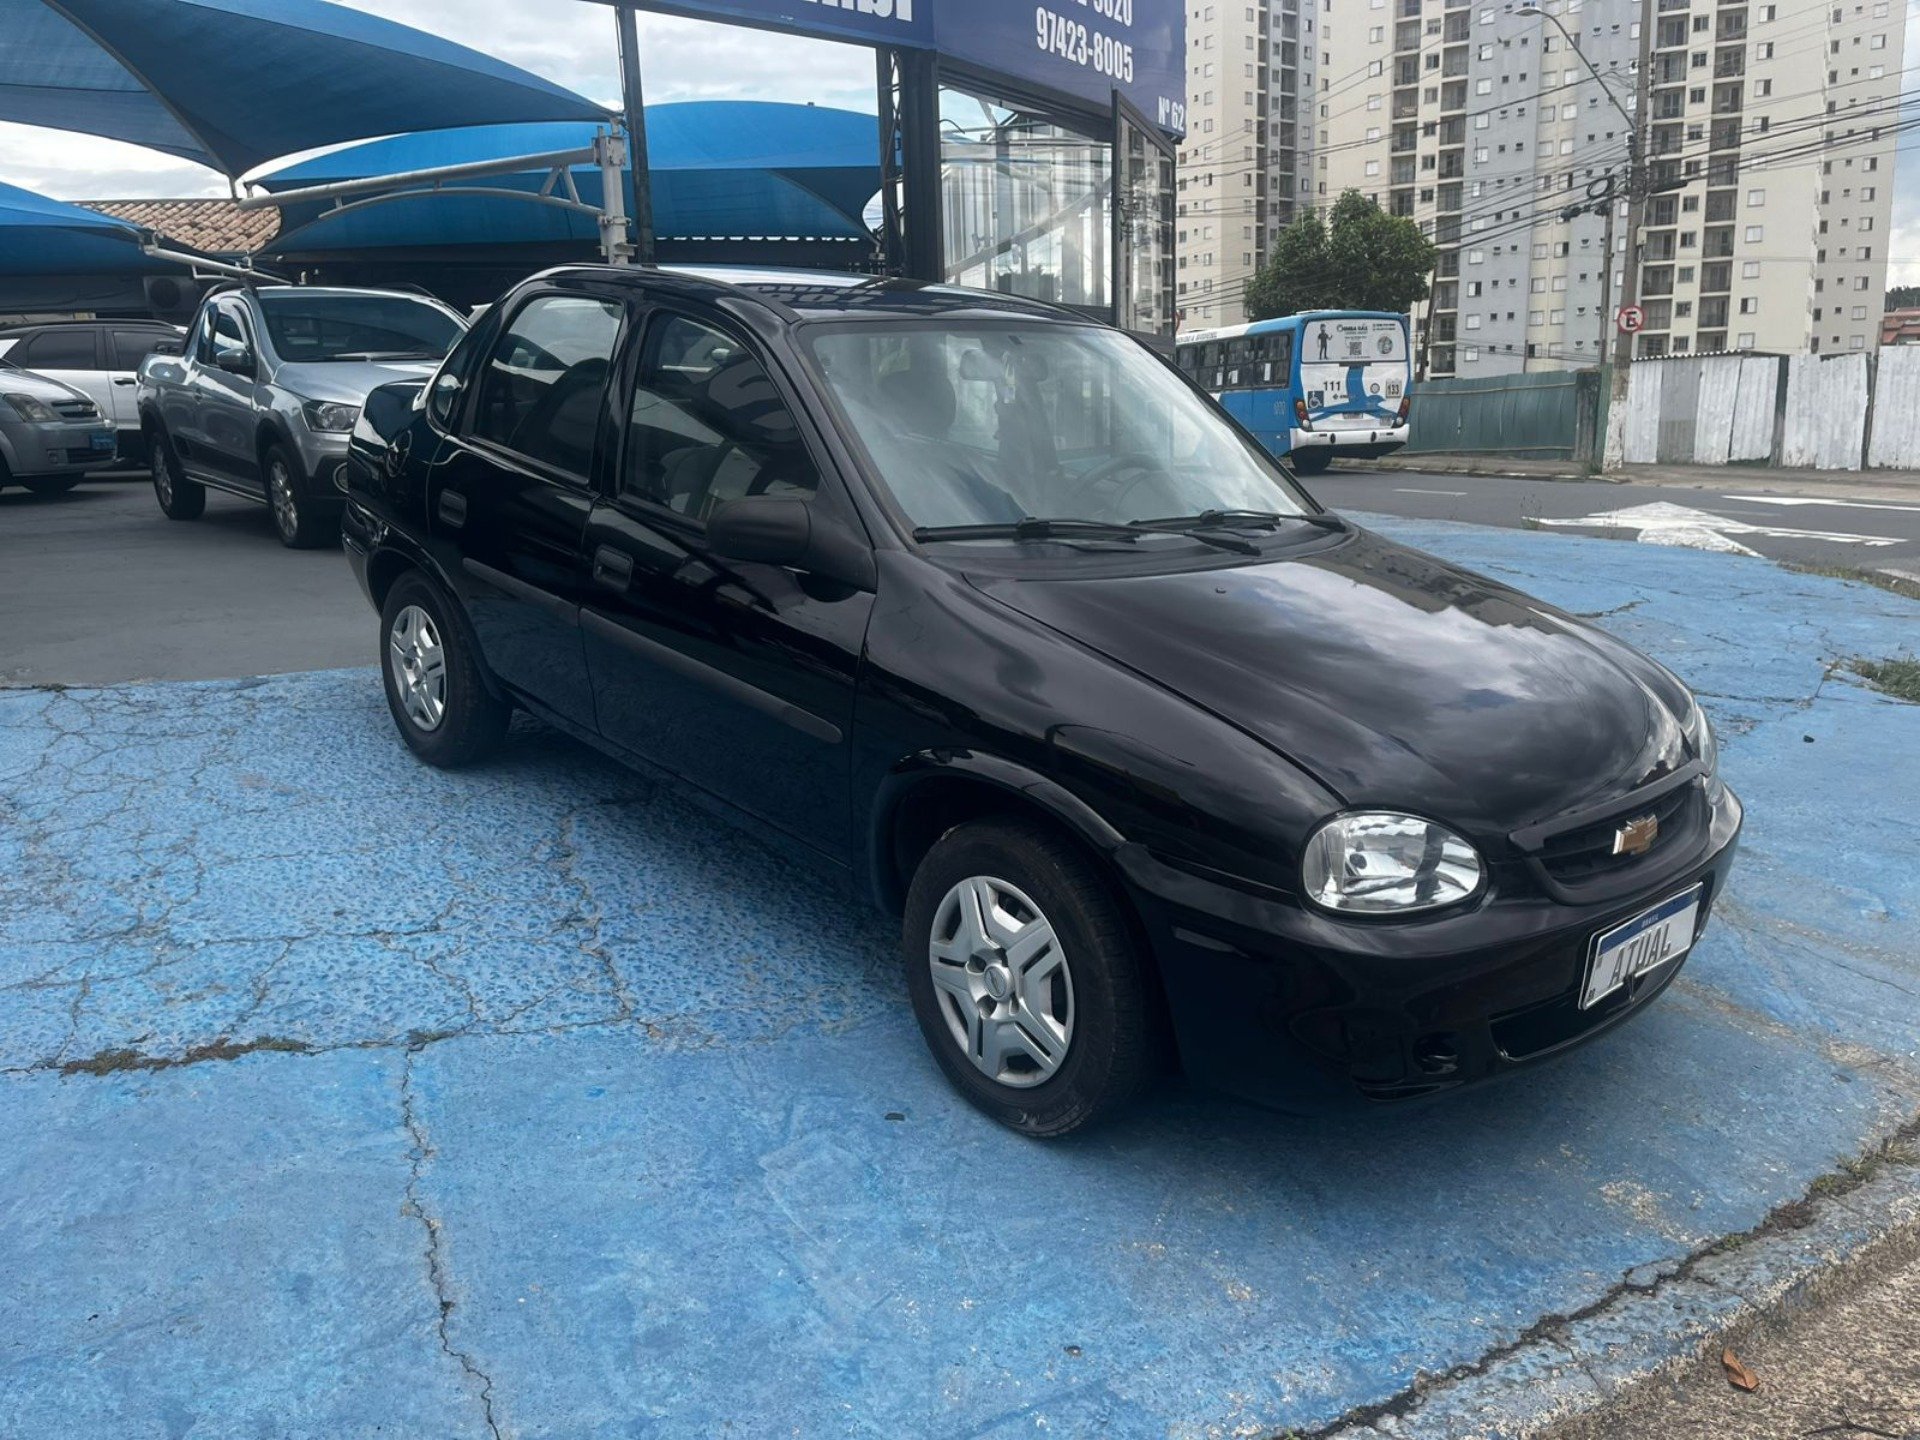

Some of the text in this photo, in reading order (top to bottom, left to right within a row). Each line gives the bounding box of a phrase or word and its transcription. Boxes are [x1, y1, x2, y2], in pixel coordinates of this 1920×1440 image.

[1036, 7, 1134, 83] 97423-8005
[1324, 381, 1341, 391] 111
[1387, 384, 1400, 396] 133
[1608, 921, 1672, 989] ATUAL
